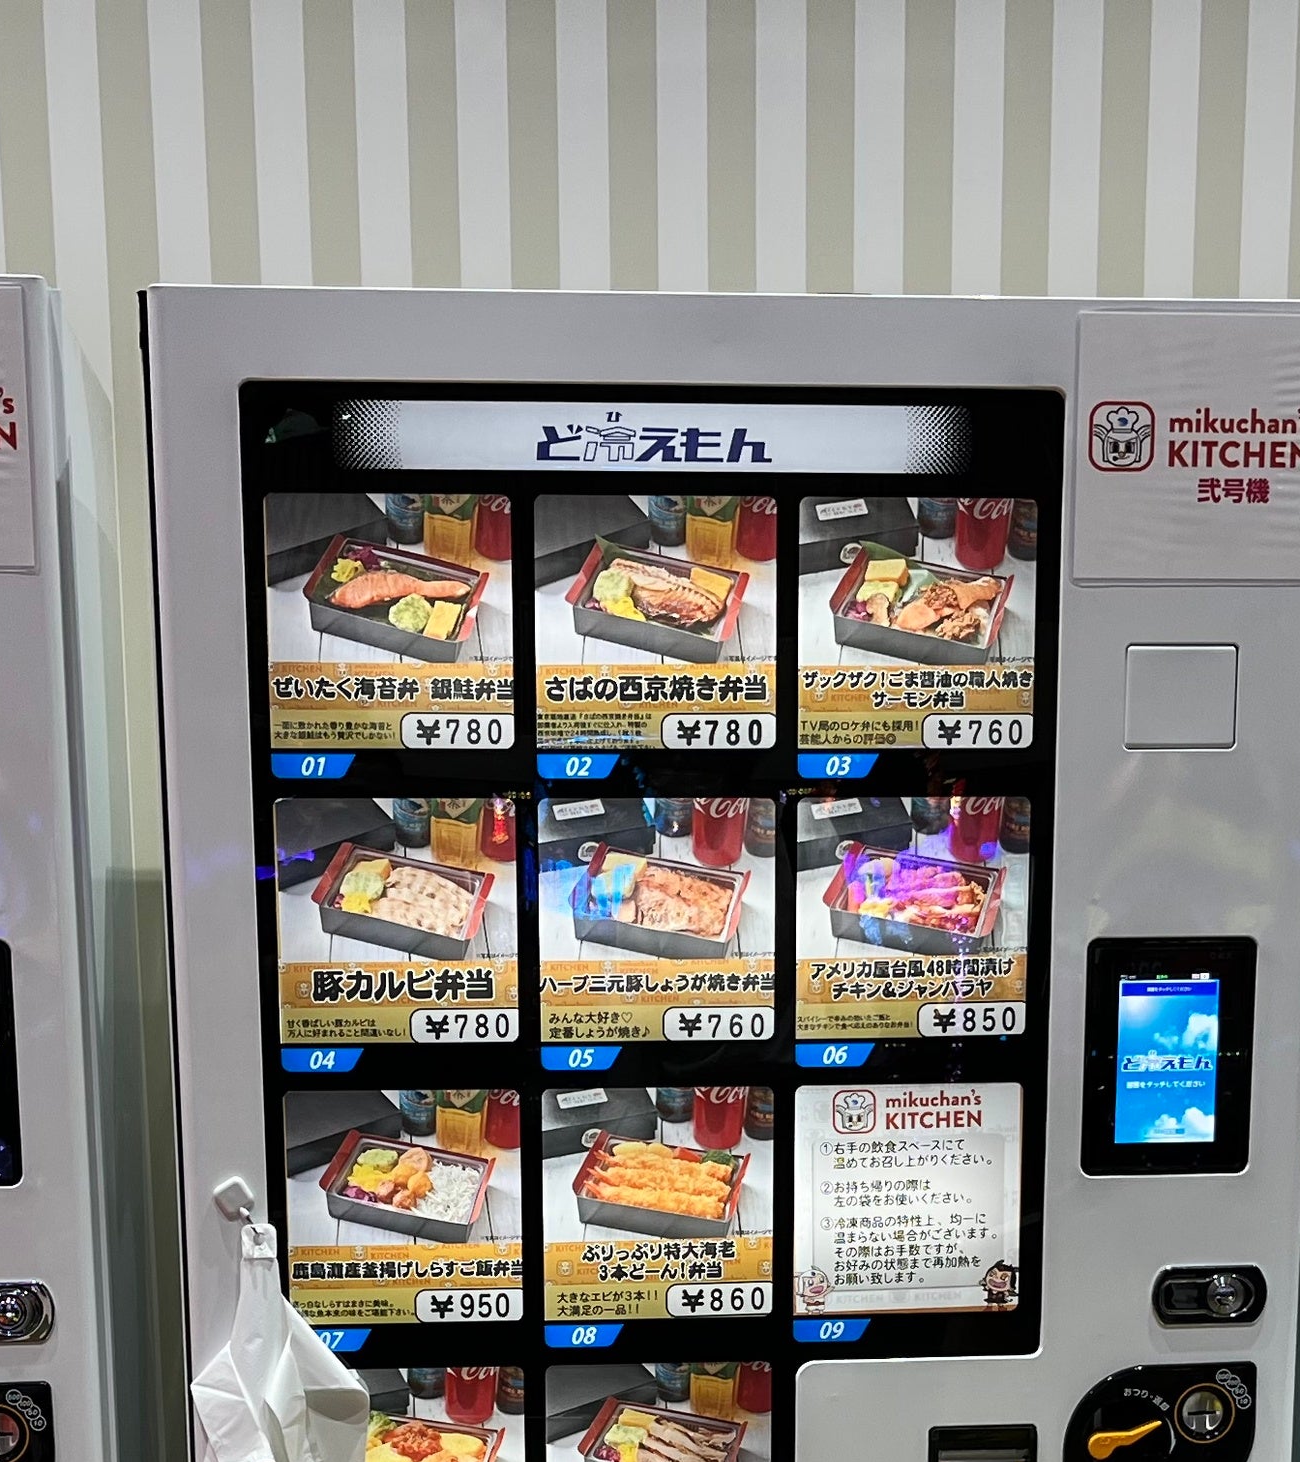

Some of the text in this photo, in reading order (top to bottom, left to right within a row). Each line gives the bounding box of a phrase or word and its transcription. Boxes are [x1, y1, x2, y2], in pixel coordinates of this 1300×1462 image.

[1197, 478, 1270, 504] 弐号機
[272, 678, 514, 701] ぜいたく海苔弁 銀鮭弁当
[544, 675, 767, 703] さばの西京焼き弁当
[872, 691, 964, 708] サーモン弁当
[417, 720, 501, 744] ¥780
[677, 719, 763, 746] ¥780
[938, 719, 1022, 746] ¥760
[300, 757, 325, 776] 01
[811, 959, 1014, 979] アメリカ屋台風48時間漬け
[312, 969, 494, 1001] 豚カルビ弁当
[540, 973, 775, 993] ハーブ三元豚しょうが焼き弁当
[426, 1013, 509, 1040] ¥780
[679, 1013, 764, 1037] ¥760
[933, 1007, 1015, 1033] ¥850
[583, 1241, 735, 1261] ぷりっぷり特大海老
[431, 1294, 509, 1318] ¥950
[682, 1288, 764, 1312] ¥860
